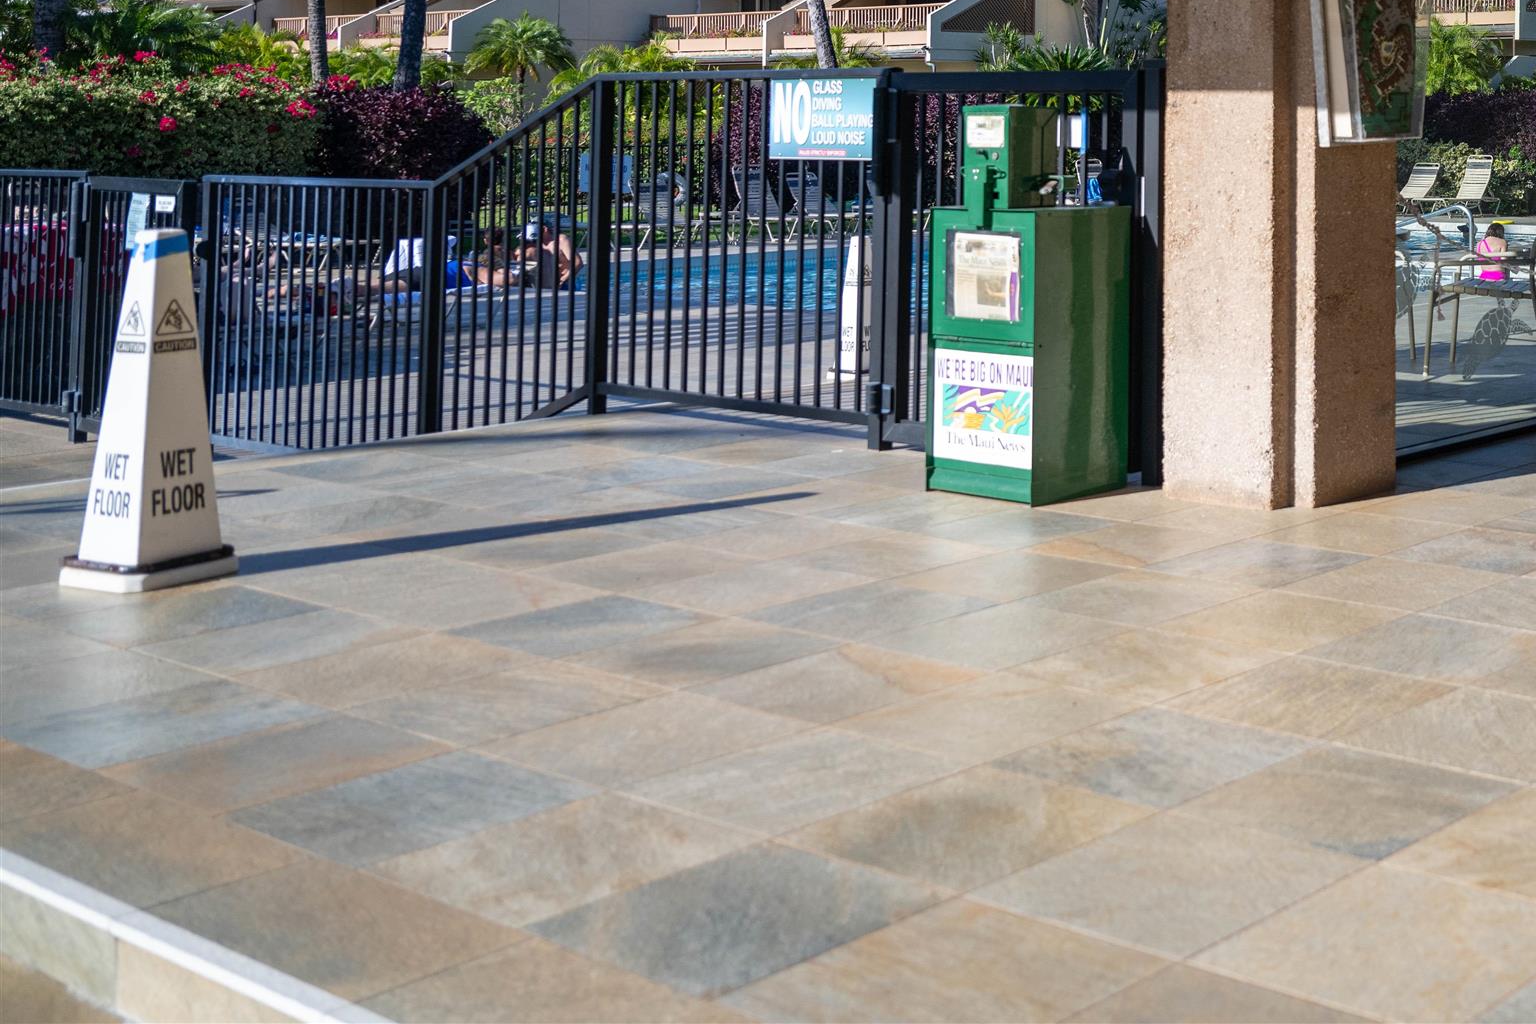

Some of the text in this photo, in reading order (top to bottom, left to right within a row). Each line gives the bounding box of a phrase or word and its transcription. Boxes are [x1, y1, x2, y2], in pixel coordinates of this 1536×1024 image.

[812, 80, 843, 94] GLASS
[773, 80, 812, 145] NO
[812, 97, 842, 111] DIVING
[811, 114, 835, 128] BALL
[811, 131, 866, 146] LOUD NOISE
[155, 338, 195, 353] CAUTION
[970, 360, 986, 383] BIG
[989, 362, 1002, 384] ON
[1006, 363, 1033, 388] MAUI
[948, 431, 1026, 454] The Maui News
[104, 452, 130, 481] WET
[160, 447, 196, 479] WET
[93, 488, 131, 519] FLOOR
[151, 482, 206, 518] FLOOR
